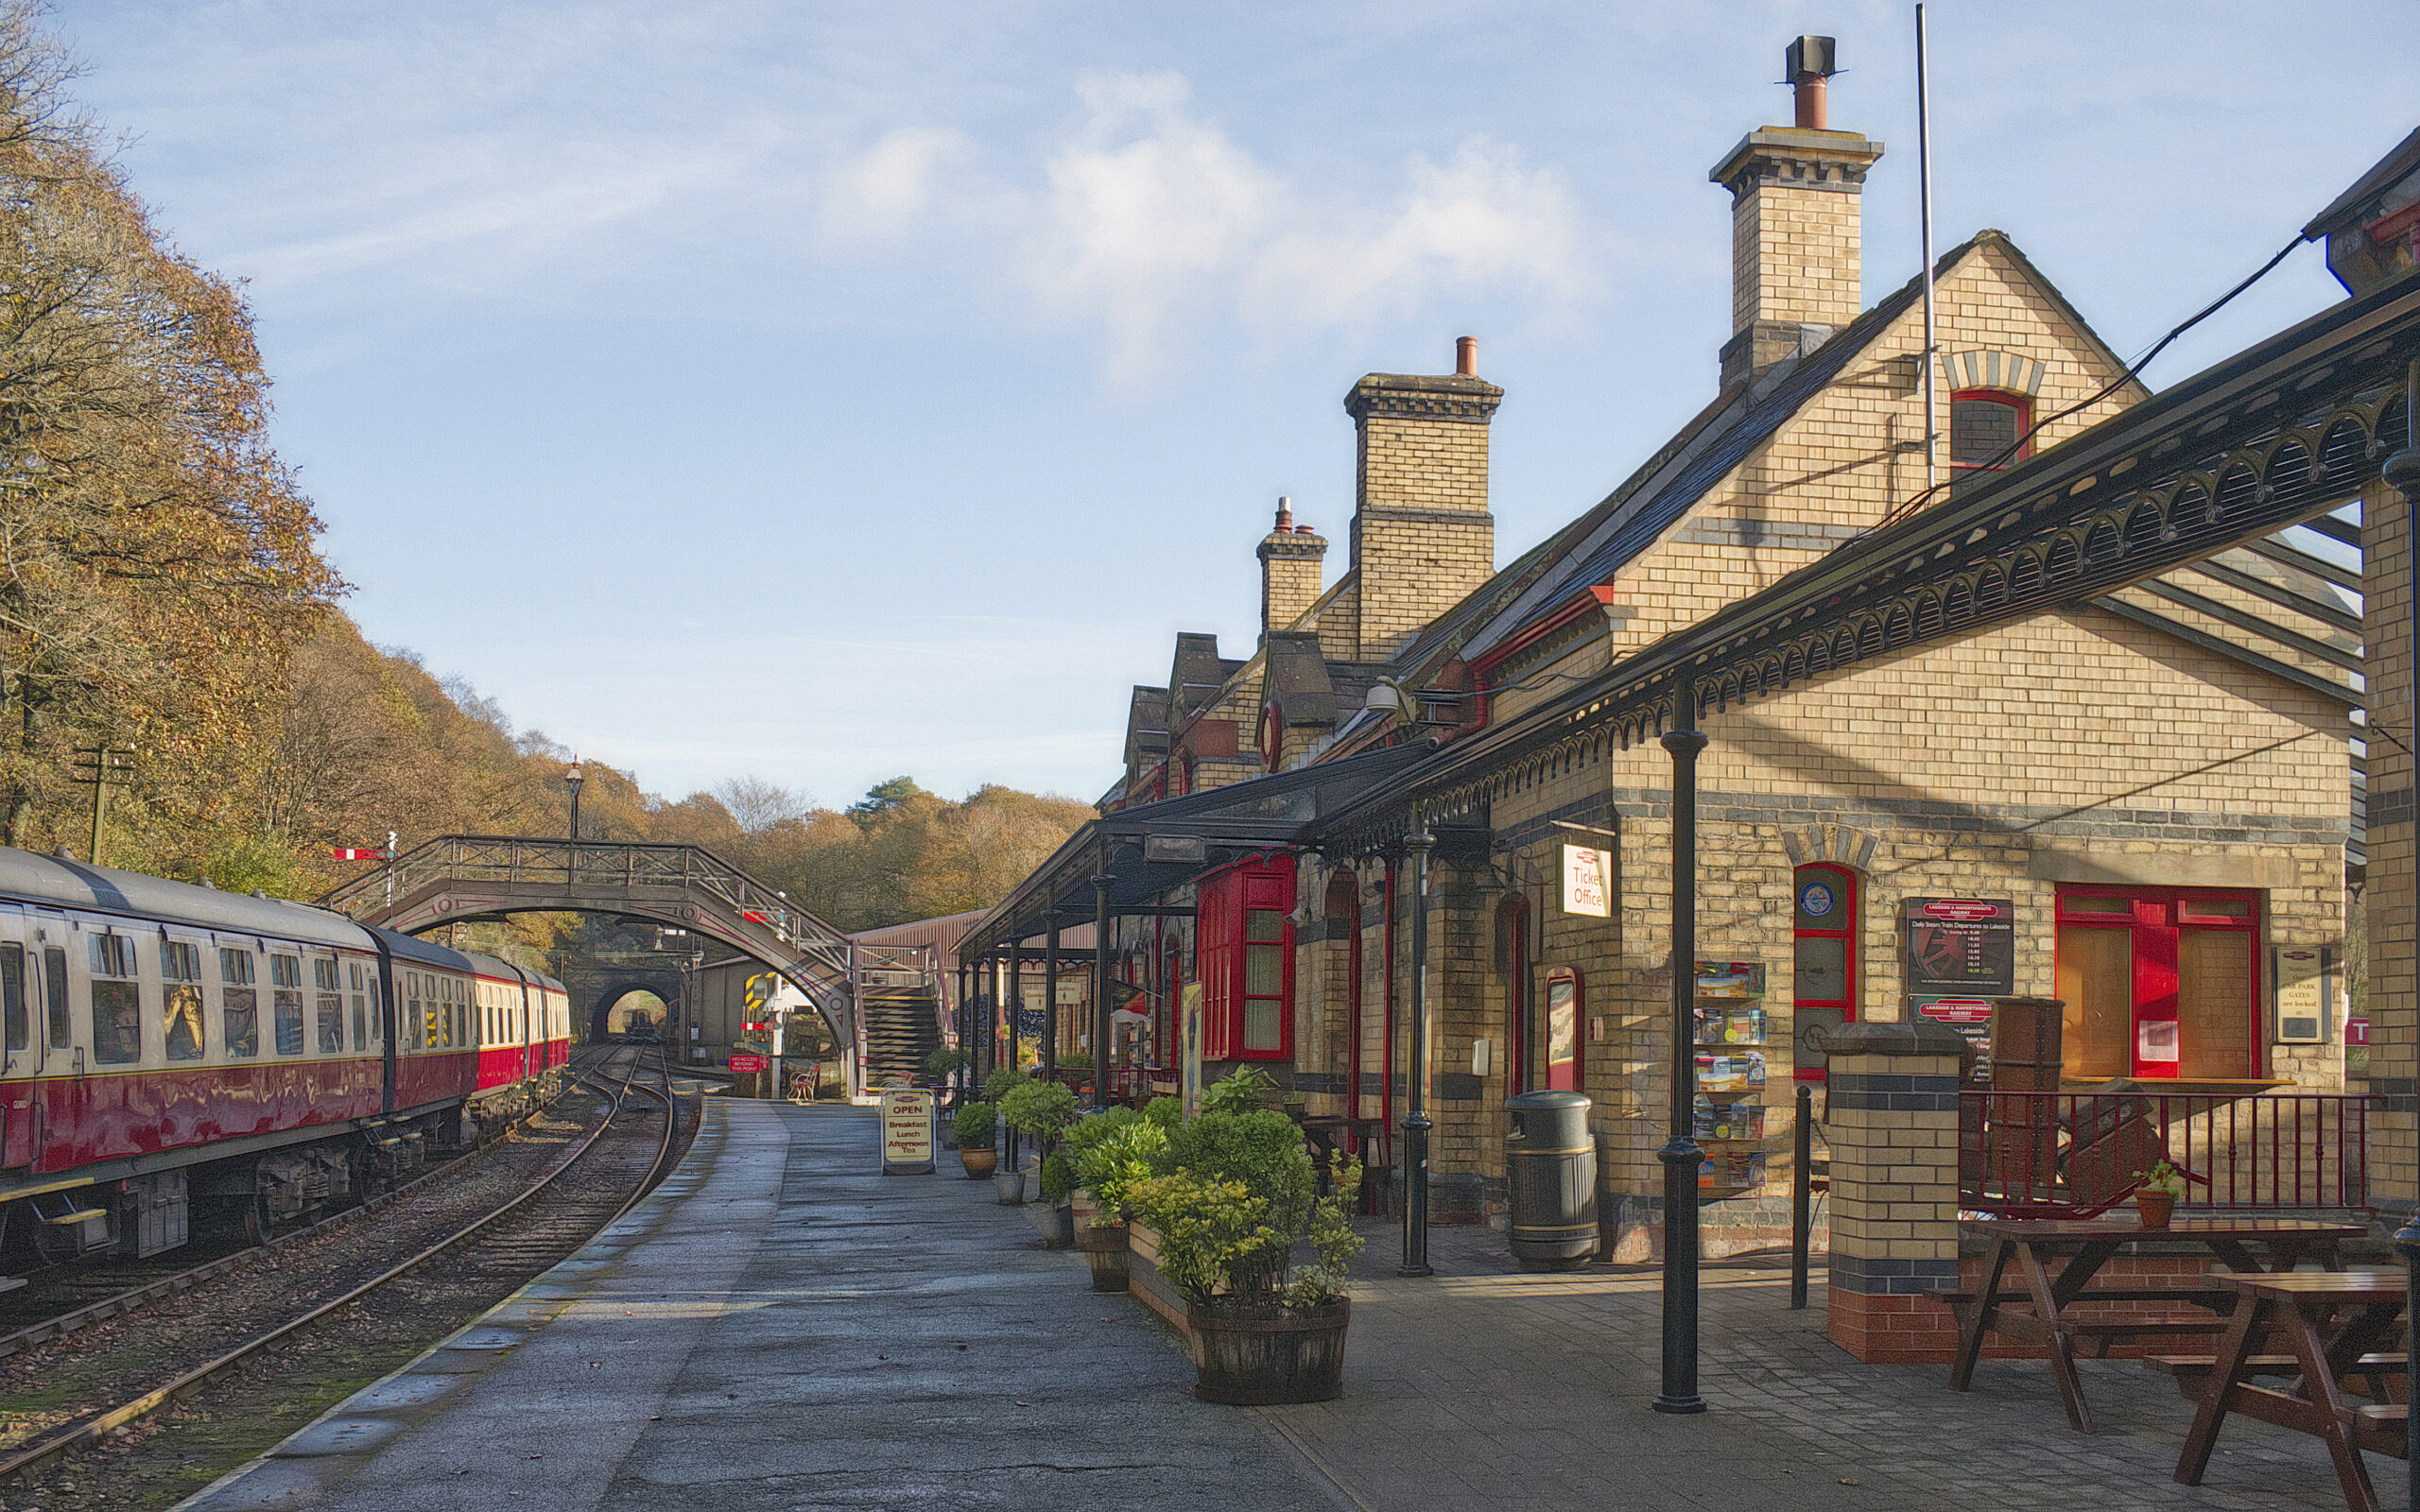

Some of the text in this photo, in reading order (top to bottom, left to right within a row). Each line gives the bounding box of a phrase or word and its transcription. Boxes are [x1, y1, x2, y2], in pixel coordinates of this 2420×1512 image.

[1573, 867, 1602, 886] Ticket
[1574, 888, 1602, 907] Office
[892, 1106, 923, 1114] OPEN
